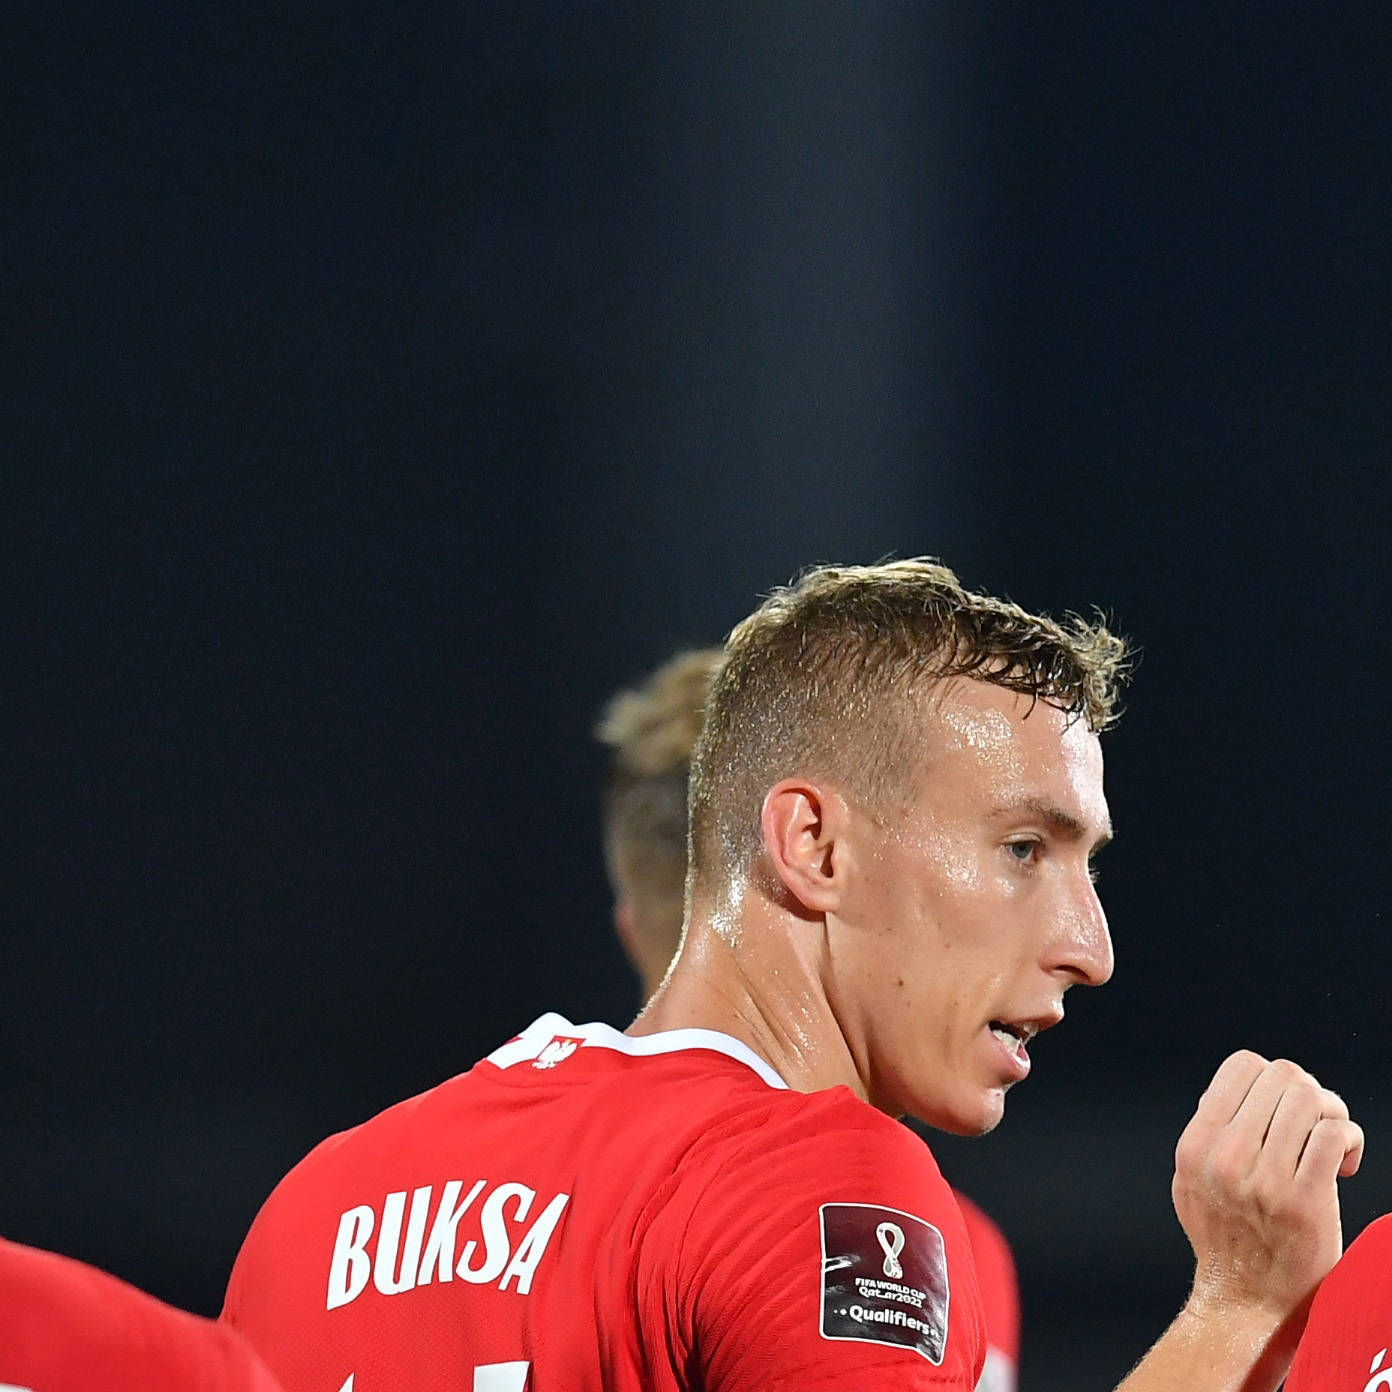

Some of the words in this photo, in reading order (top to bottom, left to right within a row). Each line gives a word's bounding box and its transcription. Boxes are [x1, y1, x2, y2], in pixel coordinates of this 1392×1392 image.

[326, 1179, 570, 1311] BUKSA
[855, 1277, 876, 1288] FIFA
[877, 1280, 910, 1295] WORLD
[910, 1288, 927, 1300] CUP
[849, 1305, 929, 1335] Qualifiers
